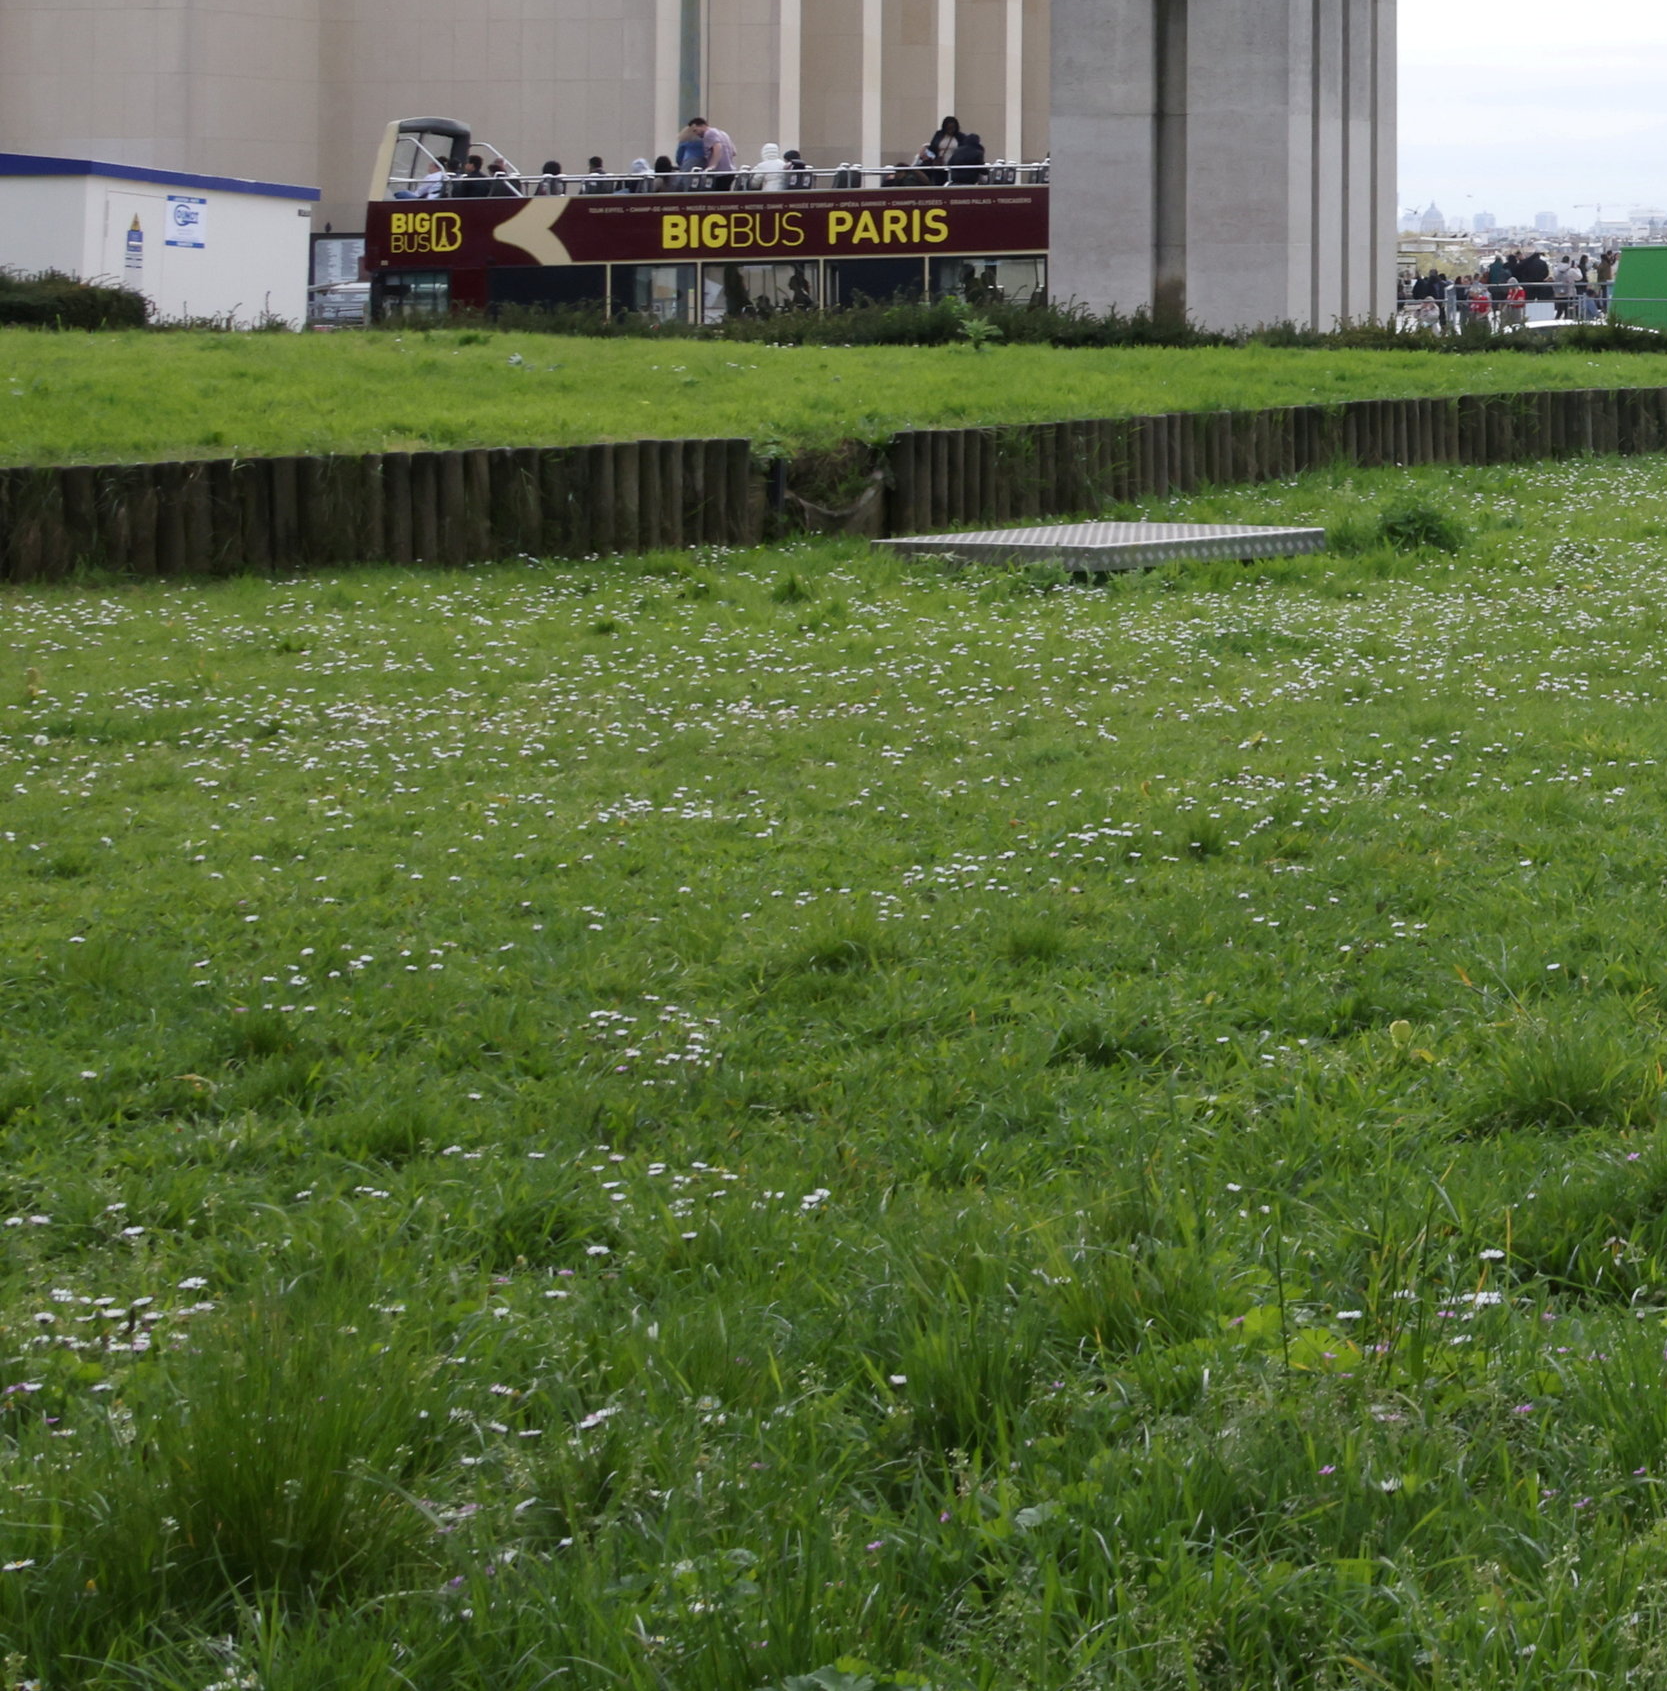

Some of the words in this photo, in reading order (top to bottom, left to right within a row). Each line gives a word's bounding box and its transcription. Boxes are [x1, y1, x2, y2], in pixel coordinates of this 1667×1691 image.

[390, 212, 431, 234] BIG
[828, 208, 950, 245] PARIS
[390, 233, 431, 254] BUS
